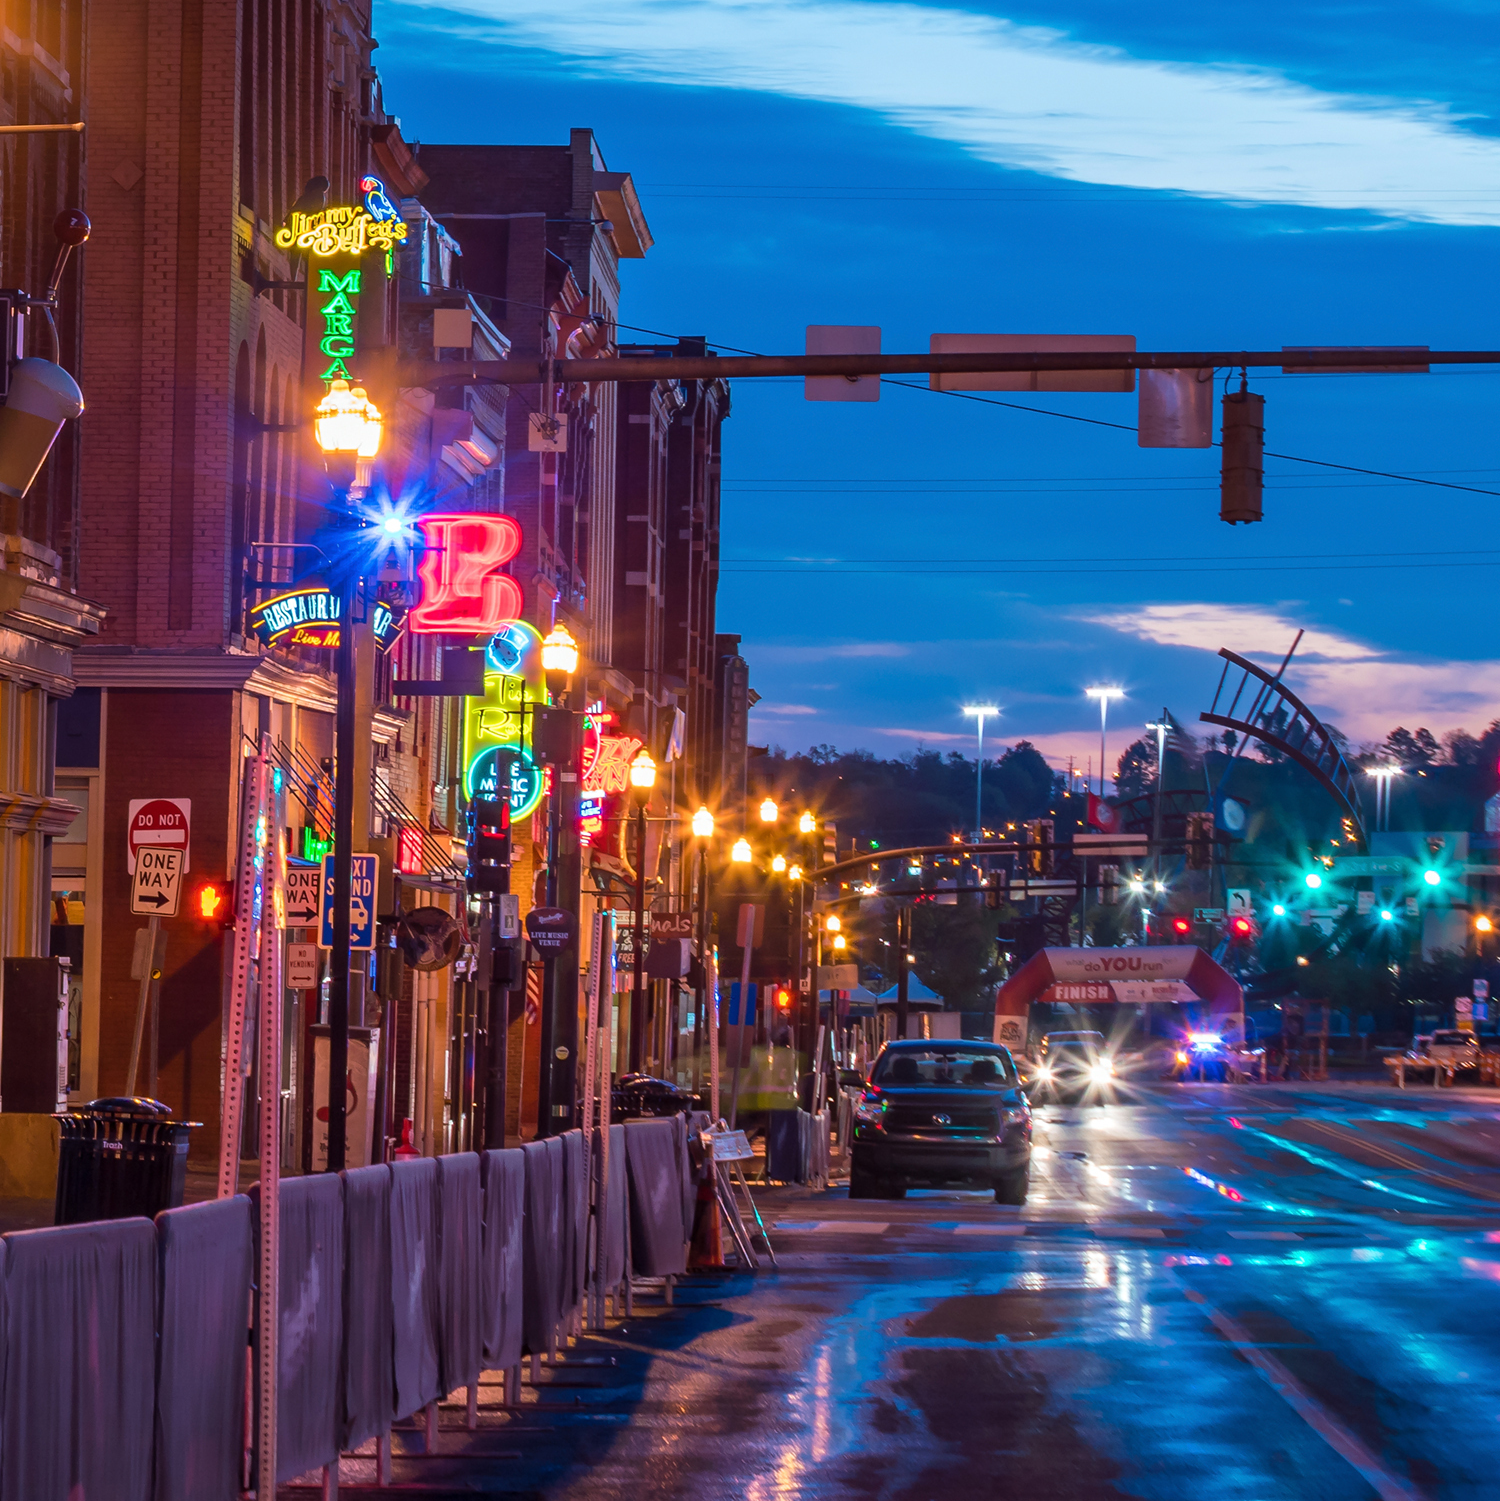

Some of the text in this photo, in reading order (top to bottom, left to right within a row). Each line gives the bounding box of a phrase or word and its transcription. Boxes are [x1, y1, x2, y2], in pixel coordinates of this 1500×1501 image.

[275, 205, 364, 248] Jimmy
[317, 268, 361, 395] MARGA
[291, 629, 322, 646] Live
[138, 813, 181, 827] DO NOT
[142, 852, 177, 870] ONE
[139, 871, 176, 888] WAY
[288, 873, 320, 887] ONE
[326, 877, 372, 897] SND
[286, 889, 319, 904] WAY
[530, 931, 569, 940] LIVE MUSIC
[538, 939, 561, 947] VENUE
[298, 950, 307, 958] NO
[617, 952, 635, 964] FREE
[289, 960, 315, 969] VENDING
[1054, 985, 1109, 1000] FINISH
[102, 1140, 123, 1150] Trash
